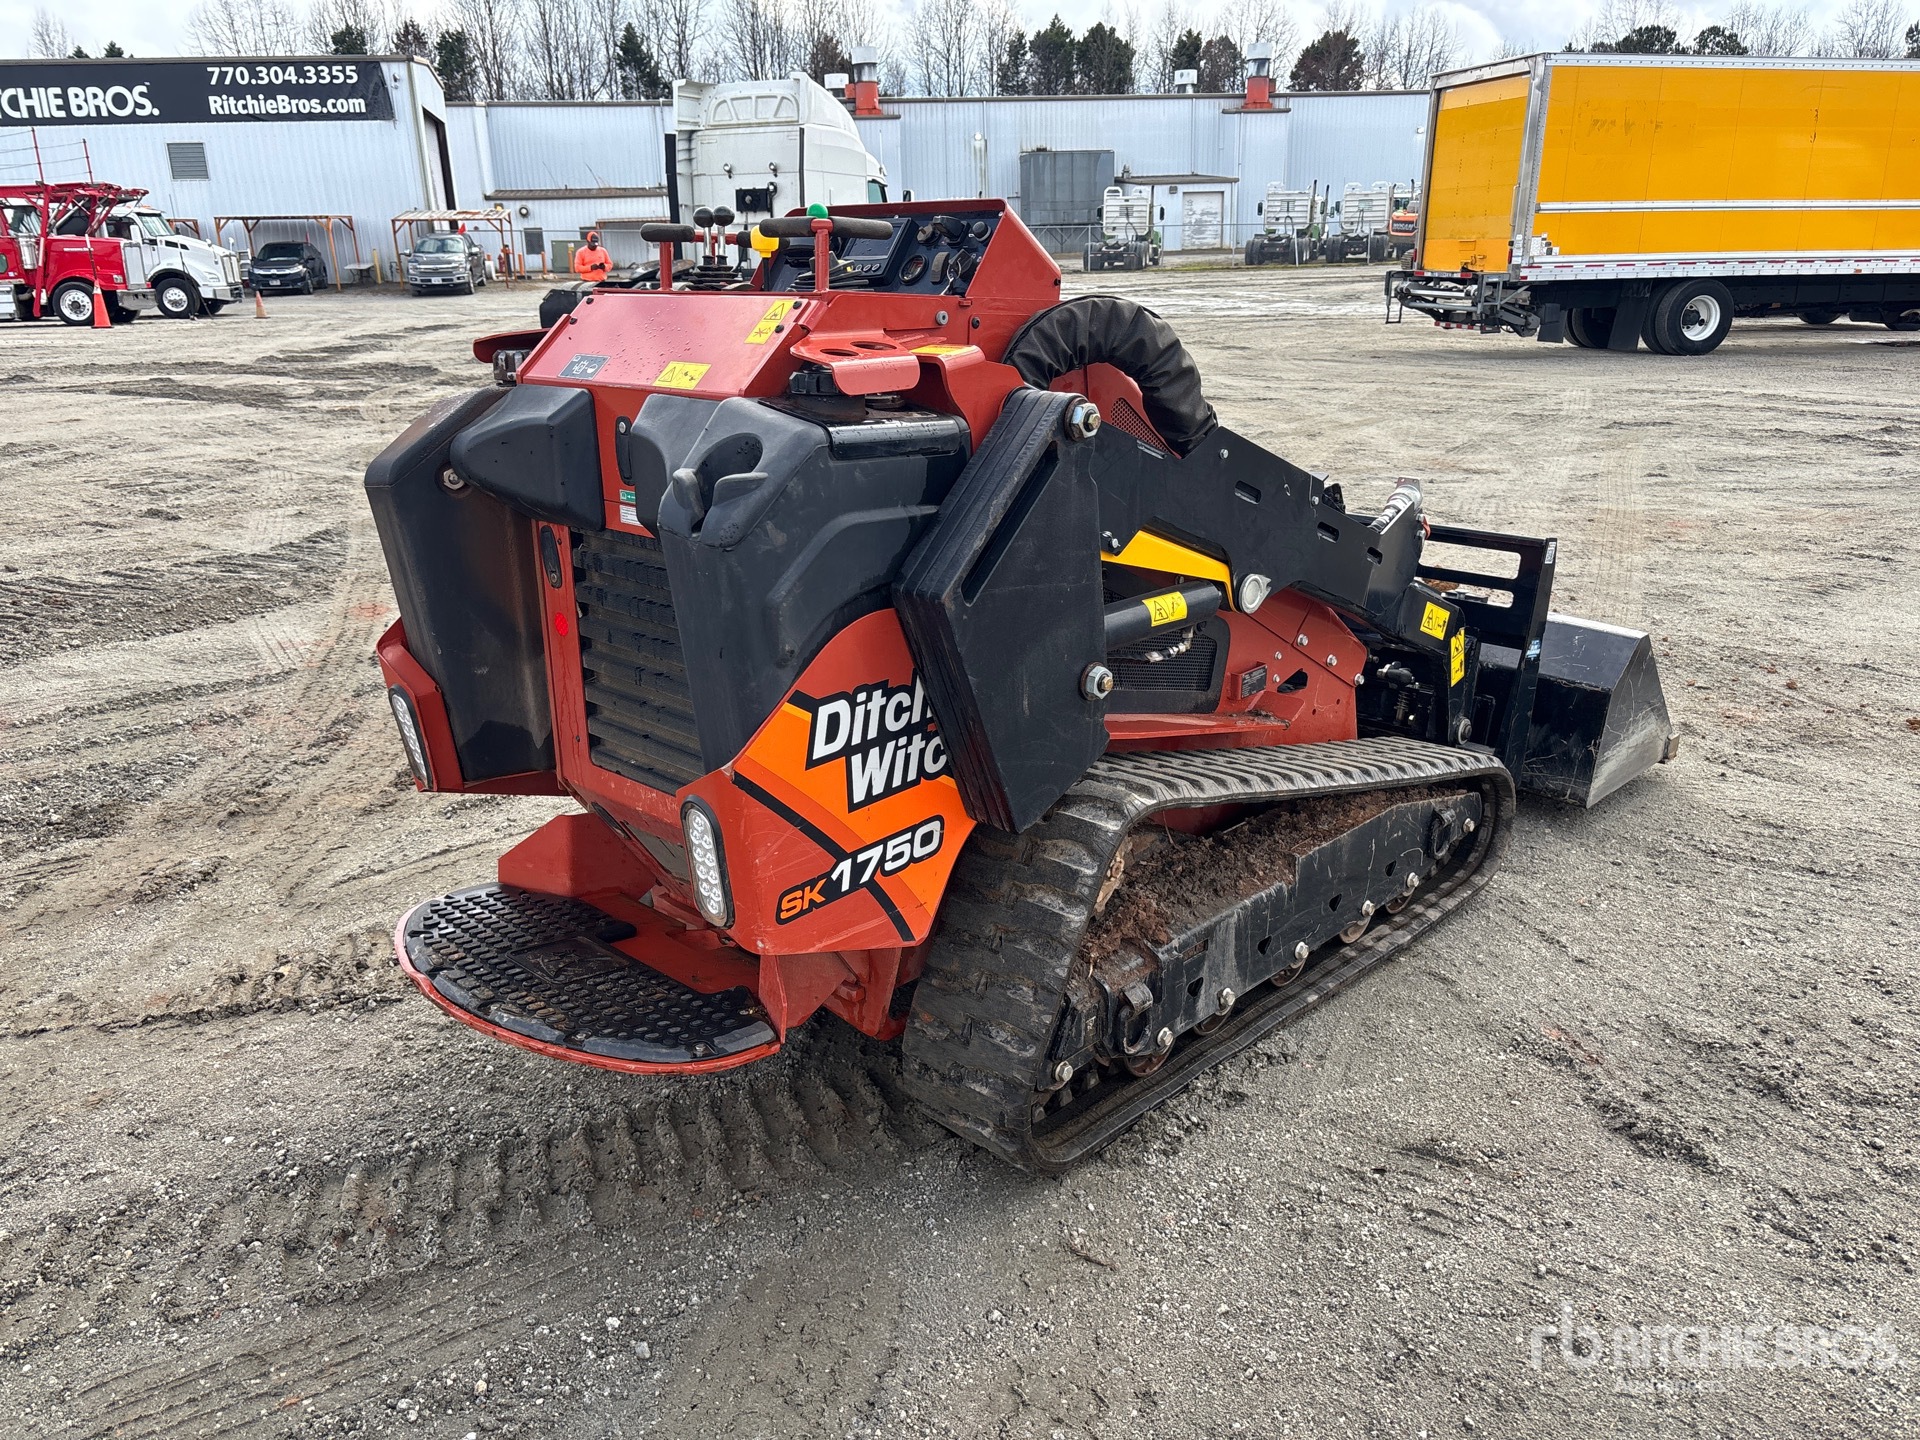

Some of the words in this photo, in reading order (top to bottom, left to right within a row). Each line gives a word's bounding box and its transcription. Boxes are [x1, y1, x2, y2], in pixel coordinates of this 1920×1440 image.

[207, 65, 359, 85] 770.304.3355
[0, 87, 66, 119] CHIE
[67, 84, 160, 117] BROS.
[207, 94, 367, 115] RitchieBros.com
[850, 732, 948, 804] Witc
